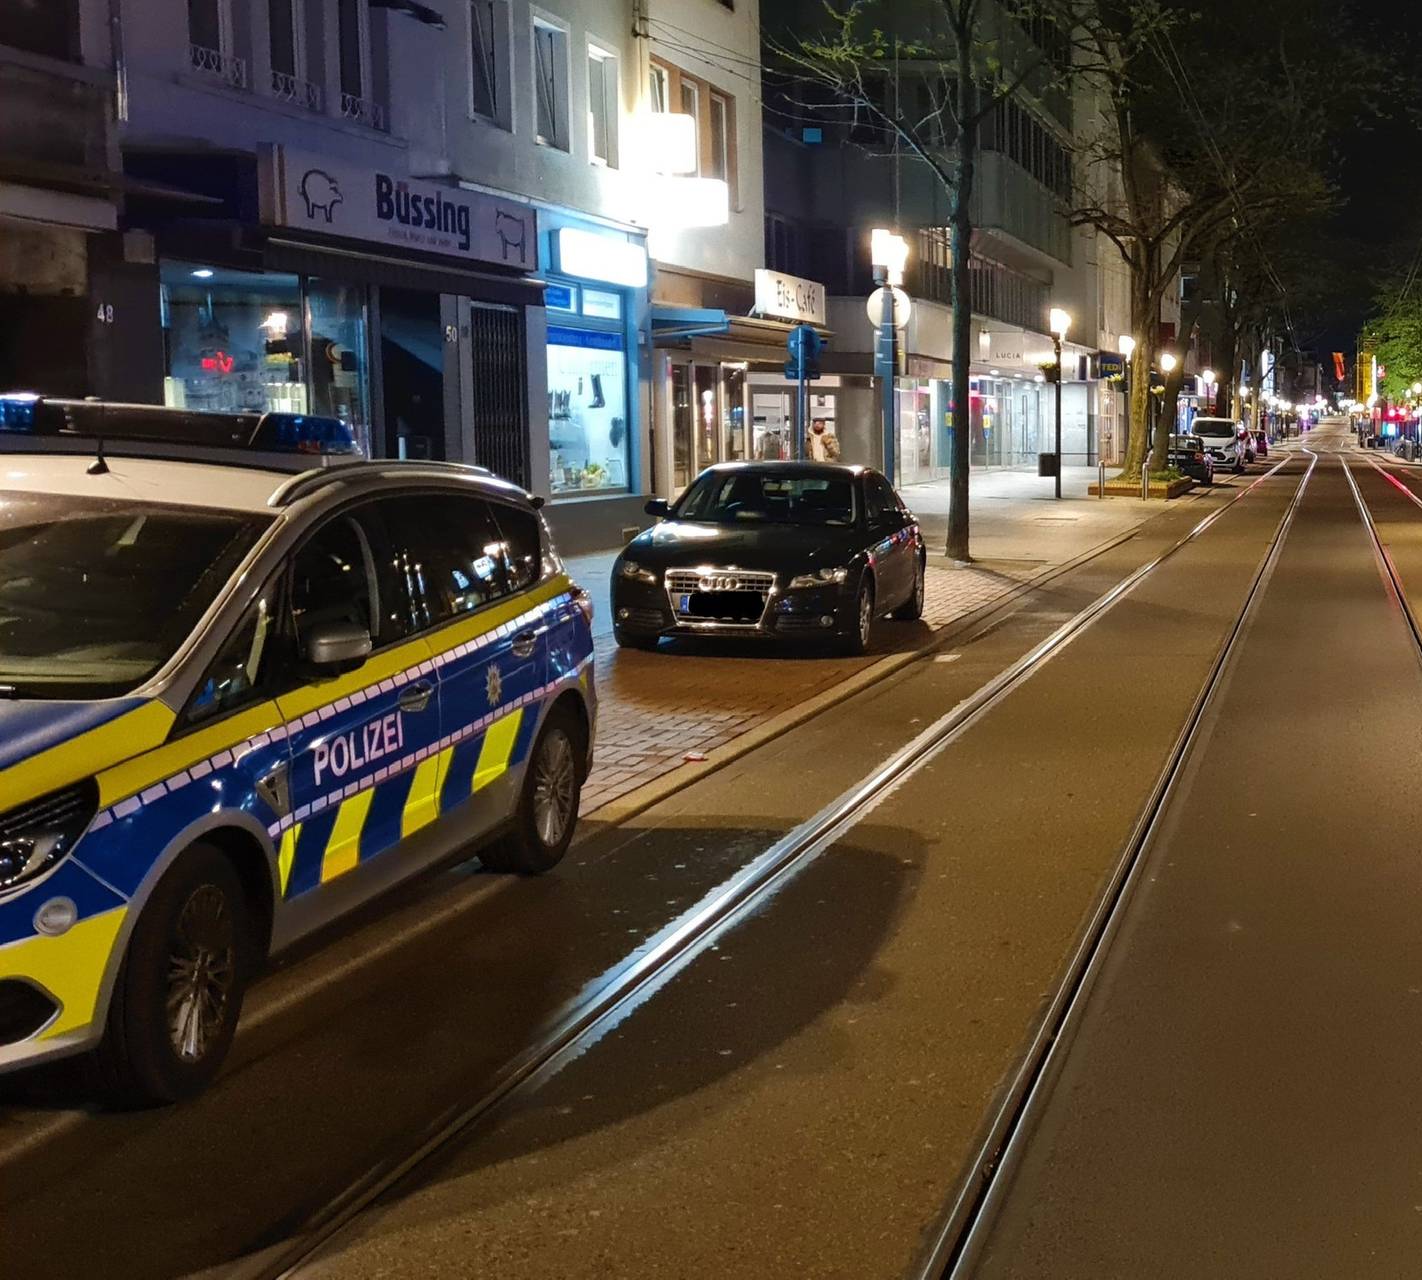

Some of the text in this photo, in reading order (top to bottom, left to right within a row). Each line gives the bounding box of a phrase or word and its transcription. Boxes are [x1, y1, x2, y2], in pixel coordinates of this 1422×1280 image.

[375, 173, 471, 251] Büssing
[97, 304, 114, 322] 48
[446, 325, 457, 342] 50
[313, 710, 404, 786] POLIZEI
